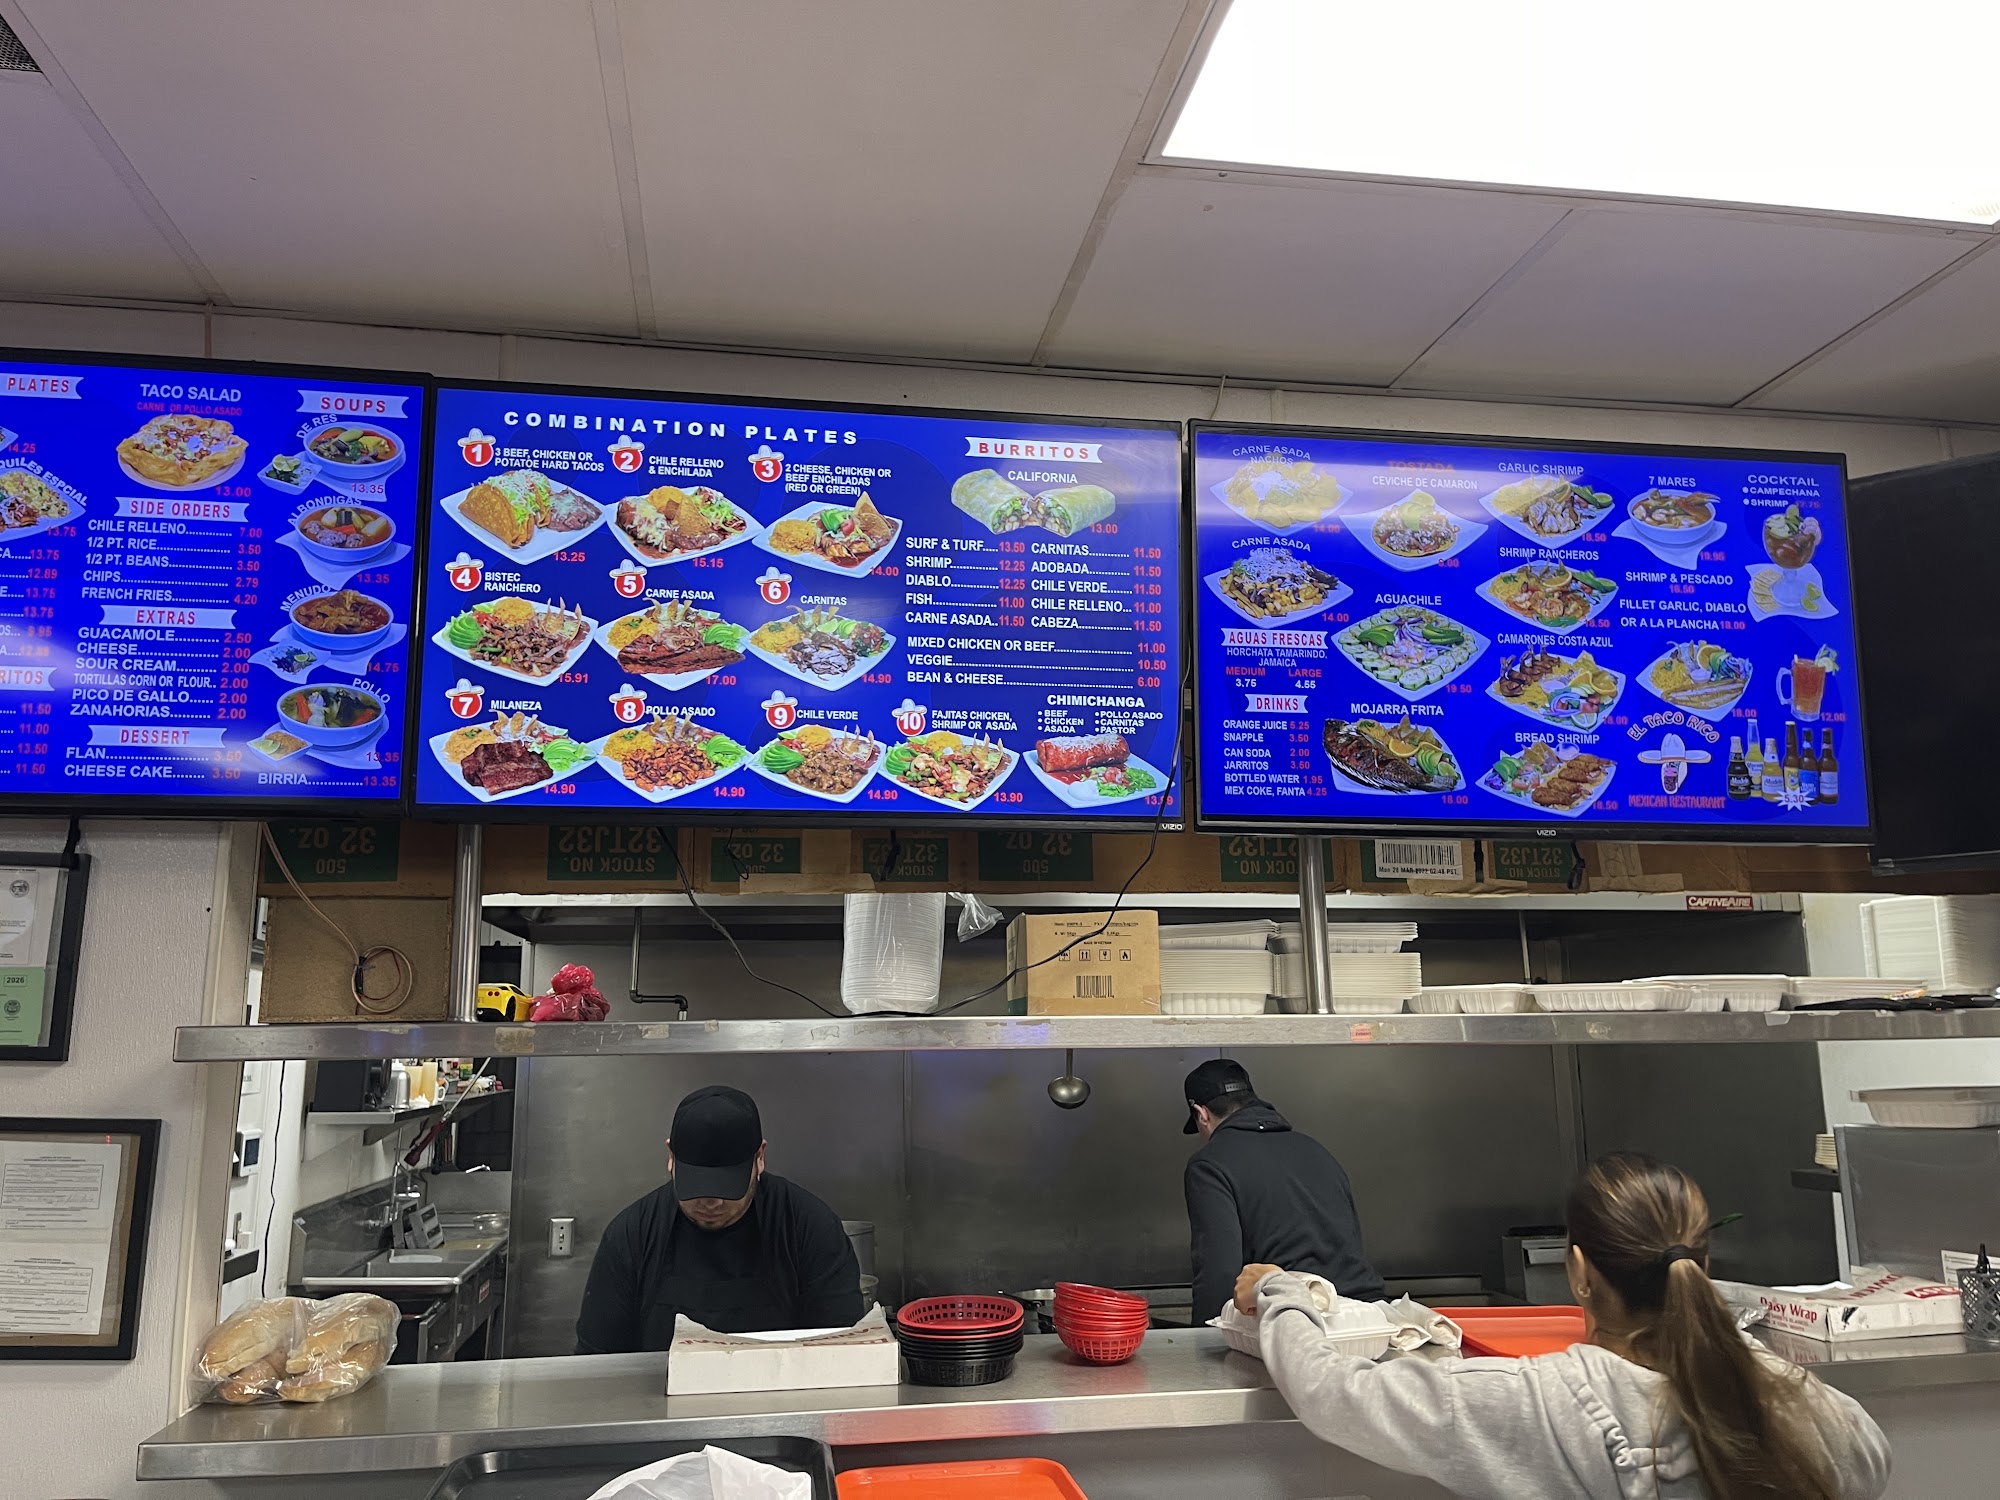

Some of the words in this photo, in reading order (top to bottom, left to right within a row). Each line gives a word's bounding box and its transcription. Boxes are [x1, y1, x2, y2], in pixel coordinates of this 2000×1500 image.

[8, 377, 69, 392] PLATES
[140, 384, 183, 398] TACO
[188, 387, 241, 402] SALAD
[321, 397, 386, 413] SOUPS
[296, 423, 313, 438] DE
[313, 414, 338, 426] RES
[504, 411, 725, 437] COMBINATION
[745, 426, 857, 445] PLATES
[472, 444, 482, 462] 1
[495, 448, 501, 456] 3
[503, 448, 530, 459] BEEF,
[533, 450, 576, 460] CHICKEN
[578, 452, 593, 461] OR
[979, 442, 1088, 459] BURRITOS
[1233, 445, 1271, 457] CARNE
[1274, 445, 1311, 460] ASADA
[495, 458, 539, 468] POTATOE
[542, 459, 569, 469] HARD
[572, 461, 604, 471] TACOS
[621, 453, 633, 470] 2
[649, 456, 678, 466] CHILE
[679, 457, 724, 468] RELLENO
[649, 466, 656, 474] &
[658, 467, 713, 478] ENCHILADA
[762, 460, 774, 477] 3
[785, 464, 791, 472] 2
[793, 464, 833, 475] CHEESE,
[835, 466, 875, 477] CHICKEN
[878, 468, 891, 477] OR
[1498, 462, 1539, 474] GARLIC
[1542, 464, 1584, 476] SHRIMP
[785, 474, 810, 483] BEEF
[812, 475, 871, 486] ENCHILADAS
[1008, 470, 1077, 483] CALIFORNIA
[1372, 475, 1412, 486] CEVICHE
[1415, 477, 1428, 487] DE
[1430, 478, 1477, 489] CAMARON
[1649, 476, 1654, 486] 7
[1658, 476, 1696, 488] MARES
[1748, 474, 1819, 487] COCKTAIL
[43, 471, 87, 506] ESPCIAL
[352, 483, 384, 494] 13.35
[785, 484, 808, 493] (RED
[810, 485, 823, 494] OR
[826, 485, 861, 497] GREEN)
[1750, 488, 1820, 498] CAMPECHANA
[130, 500, 164, 515] SIDE
[172, 503, 230, 518] ORDERS
[288, 496, 362, 525] ALBONDIGAS
[906, 537, 938, 550] SURF
[941, 539, 950, 549] &
[999, 542, 1025, 553] 13.50
[554, 552, 585, 561] 13.25
[1499, 547, 1536, 558] SHRIMP
[1538, 548, 1599, 561] RANCHEROS
[693, 558, 724, 568] 15.15
[457, 569, 471, 586] 4
[485, 572, 521, 582] BISTEC
[1626, 572, 1667, 582] SHRIMP
[1670, 573, 1678, 583] &
[1681, 573, 1732, 585] PESCADO
[484, 582, 540, 593] RANCHERO
[624, 576, 636, 593] 5
[768, 582, 781, 600] 6
[280, 584, 331, 611] MENUDO
[646, 589, 679, 599] CARNE
[681, 590, 714, 600] ASADA
[801, 595, 847, 606] CARNITAS
[1375, 594, 1442, 605] AGUACHILE
[1619, 599, 1656, 610] FILLET
[1659, 601, 1702, 612] GARLIC,
[1705, 602, 1746, 613] DIABLO
[137, 610, 195, 624] EXTRAS
[1621, 618, 1638, 628] OR
[1639, 618, 1648, 628] A
[1649, 618, 1664, 628] LA
[1667, 619, 1719, 631] PLANCHA
[907, 637, 944, 648] MIXED
[948, 638, 1000, 650] CHICKEN
[1004, 640, 1022, 651] OR
[1138, 643, 1166, 653] 11.00
[1229, 632, 1267, 644] AGUAS
[1272, 633, 1323, 646] FRESCAS
[1498, 634, 1555, 646] CAMARONES
[1558, 636, 1588, 647] COSTA
[1590, 636, 1613, 648] AZUL
[1258, 658, 1296, 667] JAMAICA
[558, 673, 588, 683] 15.91
[1226, 667, 1265, 676] MEDIUM
[1288, 668, 1322, 677] LARGE
[74, 674, 126, 685] TORTILLAS
[129, 675, 156, 686] CORN
[158, 676, 173, 687] OR
[220, 678, 248, 689] 2.00
[72, 689, 109, 700] PICO
[112, 690, 133, 701] DE
[219, 694, 247, 704] 2.00
[353, 678, 390, 703] POLLO
[458, 697, 474, 715] 7
[490, 700, 542, 711] MILANEZA
[1047, 695, 1145, 707] CHIMICHANGA
[1256, 698, 1299, 711] DRINKS
[622, 703, 636, 720] 8
[646, 706, 679, 715] POLLO
[682, 706, 715, 716] ASADO
[797, 710, 825, 719] CHILE
[826, 711, 858, 720] VERDE
[932, 710, 968, 720] FAJITAS
[970, 711, 1012, 721] CHICKEN,
[1100, 711, 1130, 719] POLLO
[1132, 712, 1163, 720] ASADO
[1351, 703, 1408, 715] MOJARRA
[1411, 705, 1444, 715] FRITA
[775, 707, 788, 726] 9
[901, 712, 920, 731] 10
[1045, 717, 1084, 725] CHICKEN
[1100, 718, 1144, 727] CARNITAS
[932, 720, 966, 729] SHRIMP
[968, 721, 982, 729] OR
[986, 721, 1017, 730] ASADA
[1045, 725, 1076, 733] ASADA
[1100, 726, 1136, 734] PASTOR
[1223, 720, 1260, 730] ORANGE
[1262, 721, 1287, 730] JUICE
[1627, 724, 1646, 741] EL
[1643, 711, 1684, 727] TACO
[1686, 716, 1720, 743] RICO
[121, 729, 189, 744] DESSERT
[1223, 733, 1264, 742] SNAPPLE
[1289, 734, 1309, 743] 3.50
[1515, 733, 1555, 742] BREAD
[1558, 734, 1599, 744] SHRIMP
[1629, 794, 1666, 808] MEXICAN
[1669, 796, 1726, 809] RESTAURANT
[341, 826, 376, 854] 32
[316, 858, 346, 874] 500
[601, 857, 654, 872] STOCK
[1790, 1305, 1817, 1322] Wrap
